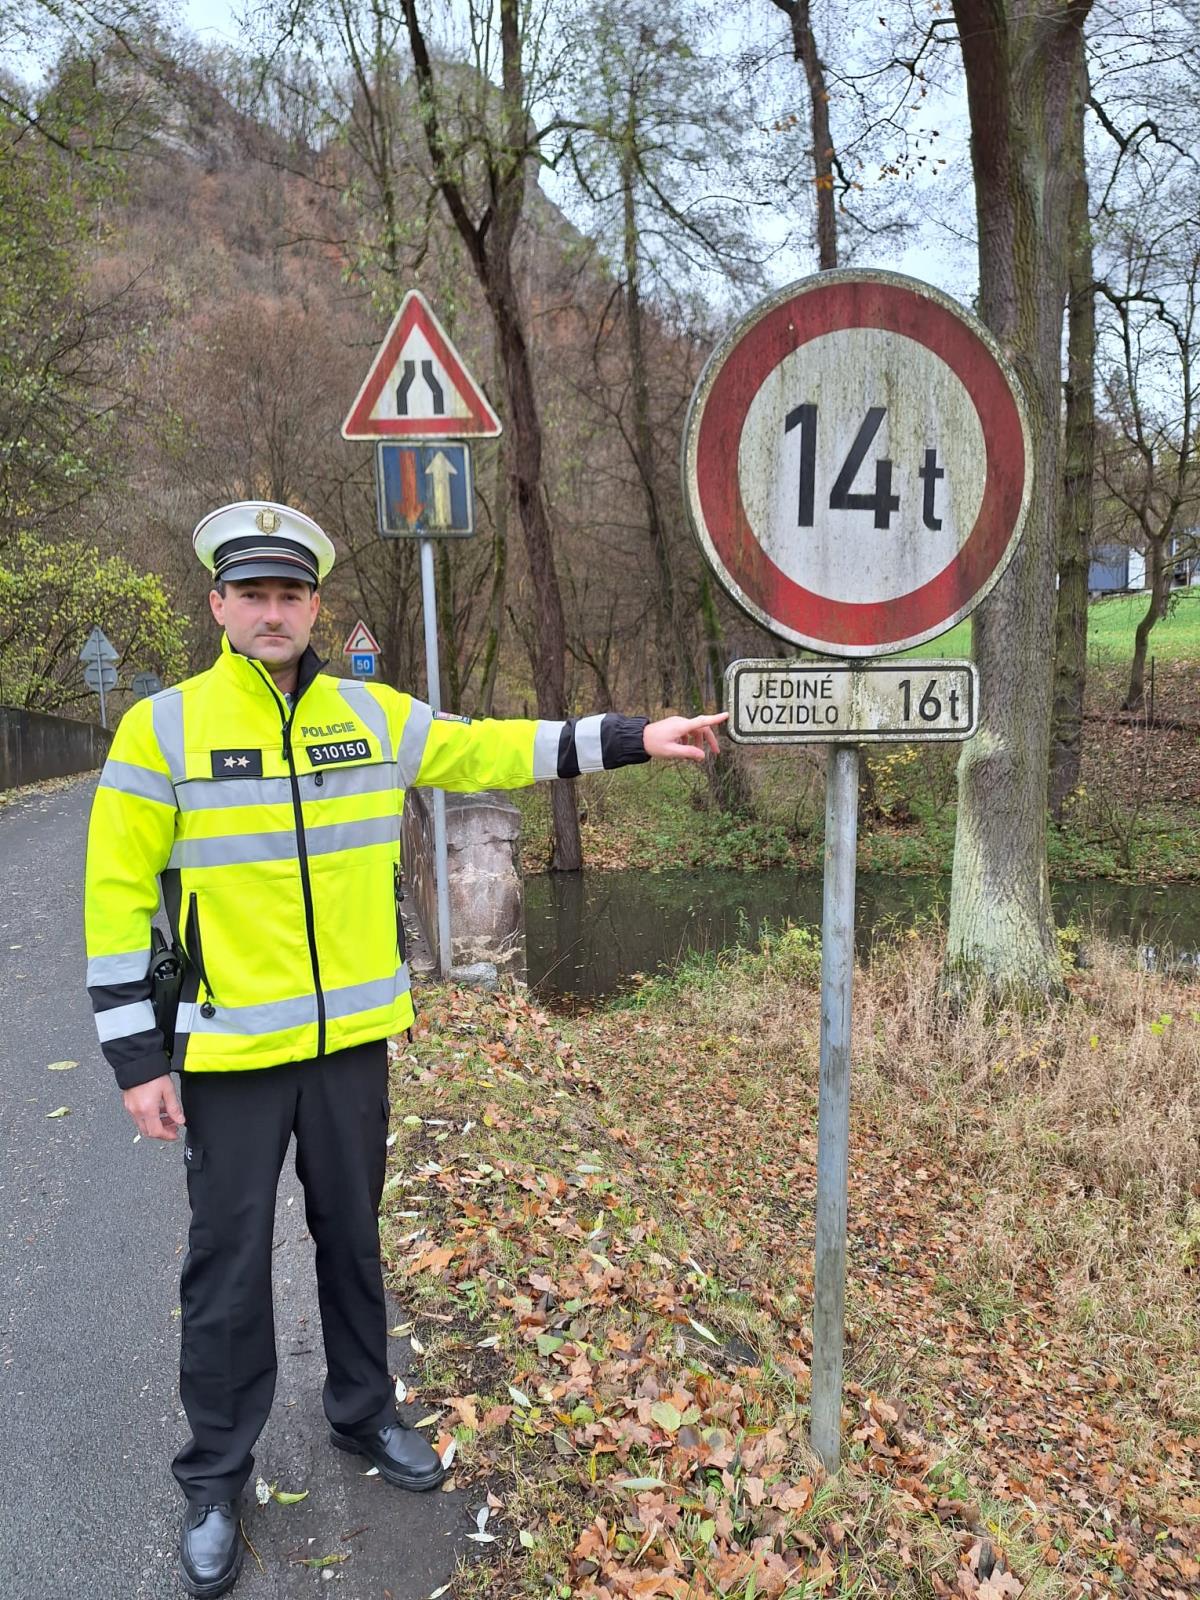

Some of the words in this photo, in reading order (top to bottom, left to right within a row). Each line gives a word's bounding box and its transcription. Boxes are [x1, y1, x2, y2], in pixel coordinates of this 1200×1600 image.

[357, 660, 370, 671] 50
[752, 674, 833, 699] JEDINÉ
[746, 705, 839, 725] VOZIDLO
[301, 722, 356, 737] POLICIE
[312, 742, 365, 761] 310150
